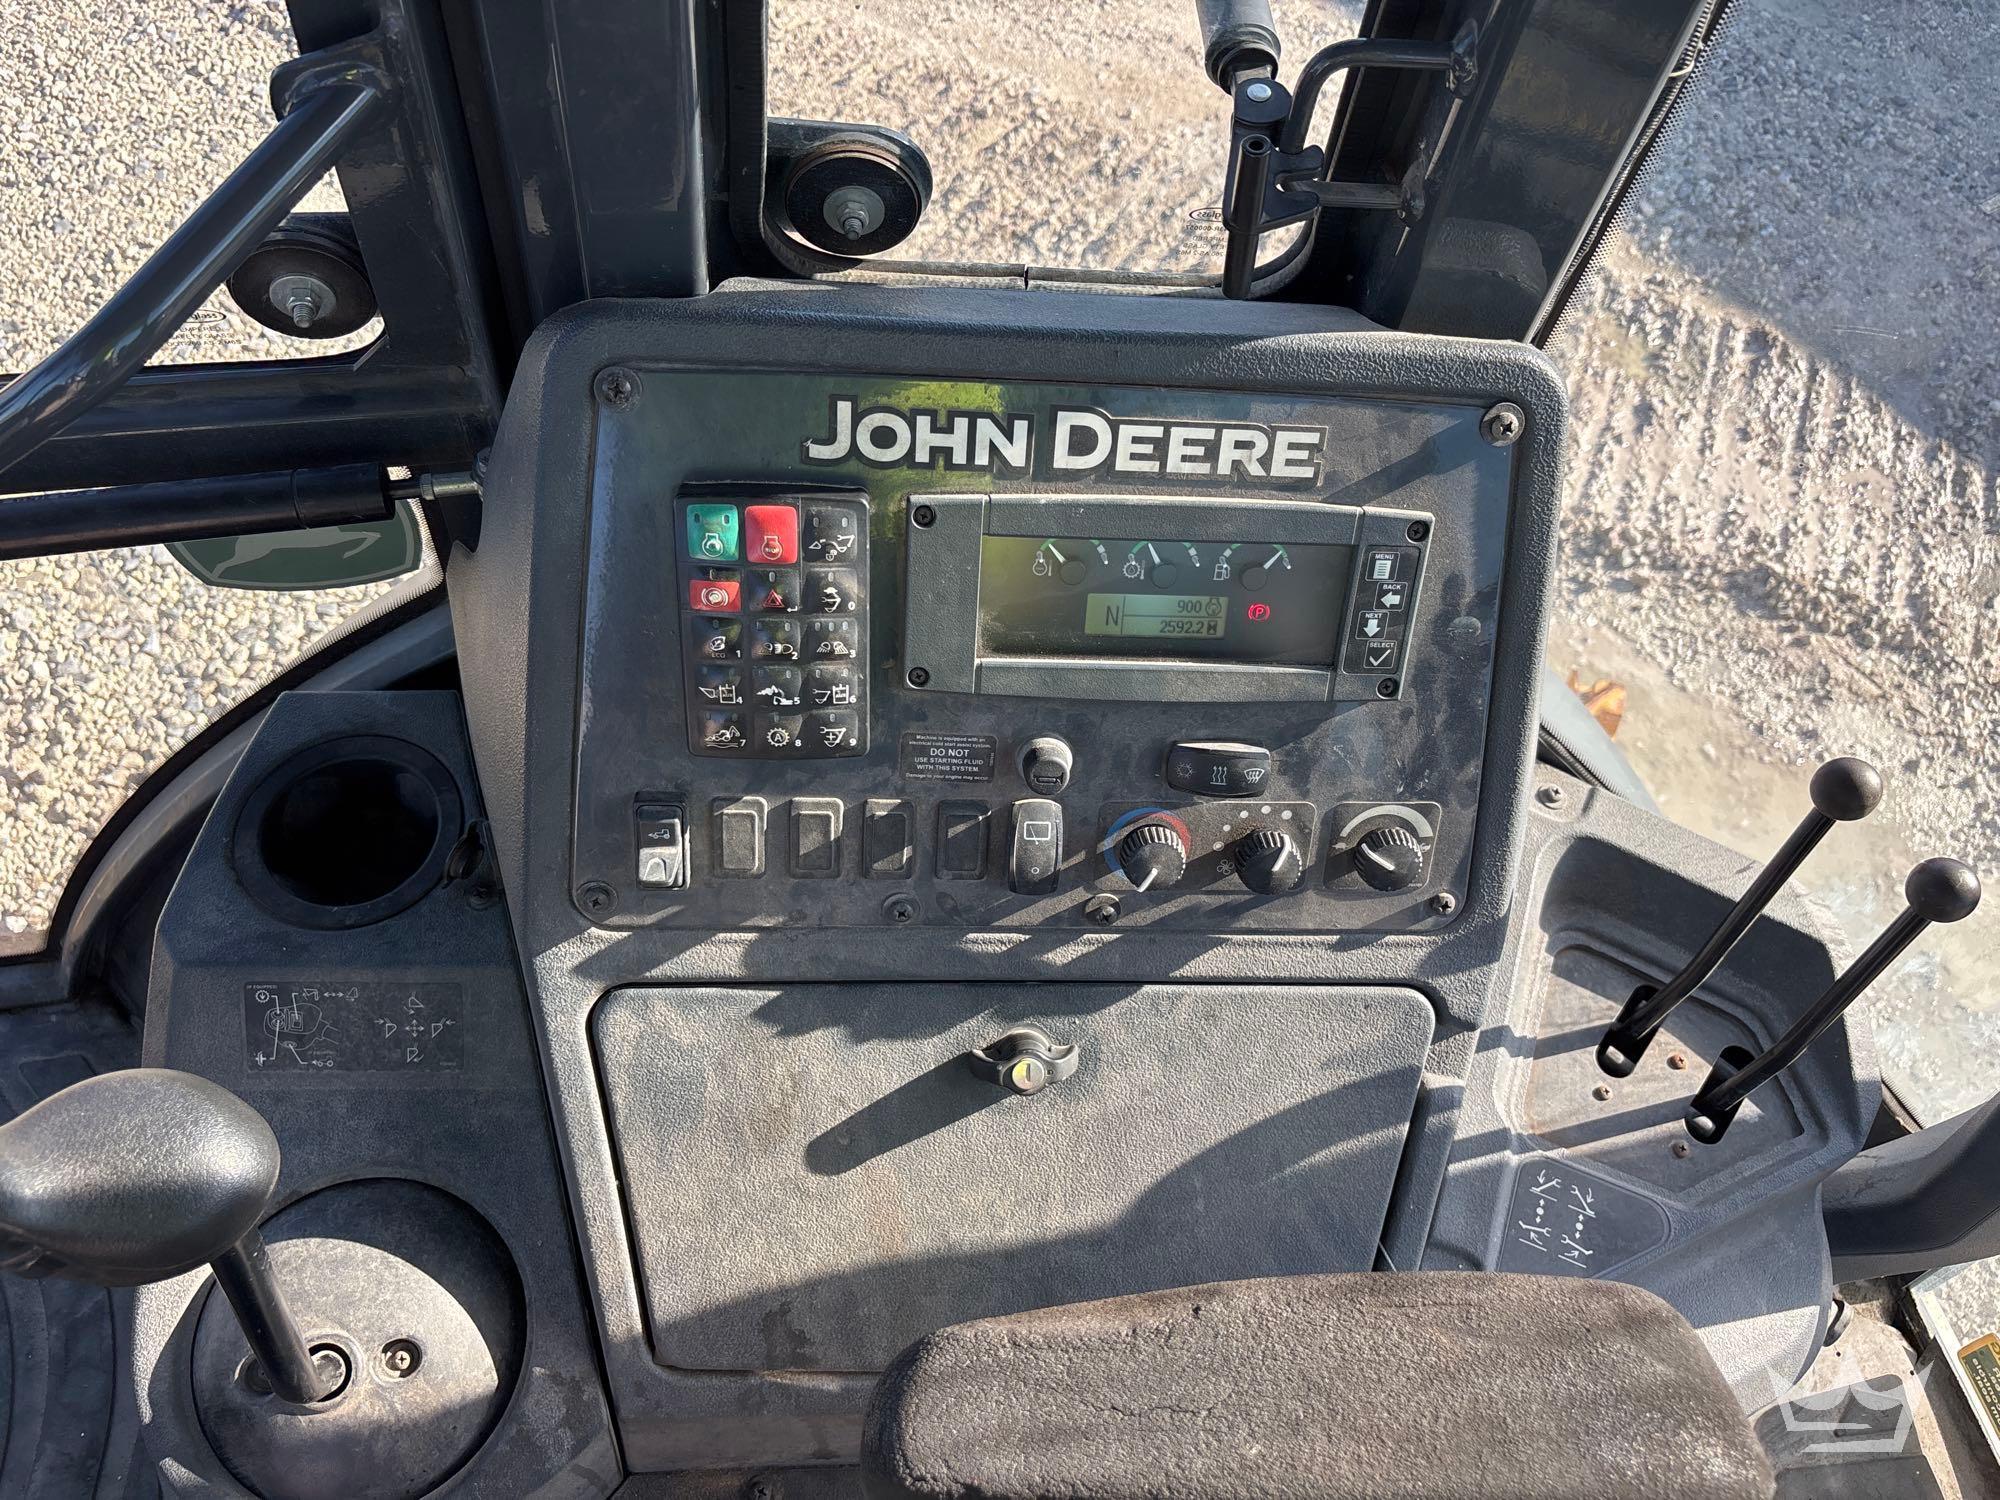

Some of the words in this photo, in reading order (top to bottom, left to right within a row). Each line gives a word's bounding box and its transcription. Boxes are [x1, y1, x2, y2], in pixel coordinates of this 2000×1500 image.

[806, 400, 1032, 467] JOHN
[1053, 410, 1320, 478] DEERE
[848, 601, 856, 611] 0
[1177, 600, 1201, 614] 900
[1105, 605, 1120, 627] N
[1159, 619, 1204, 634] 2592.2
[735, 649, 741, 658] 1
[791, 651, 798, 660] 2
[849, 649, 857, 659] 3
[736, 696, 743, 704] 4
[793, 696, 801, 705] 5
[849, 695, 857, 704] 6
[740, 739, 747, 748] 7
[794, 739, 802, 748] 8
[849, 738, 857, 747] 9
[930, 748, 945, 756] DO
[948, 748, 970, 757] NOT
